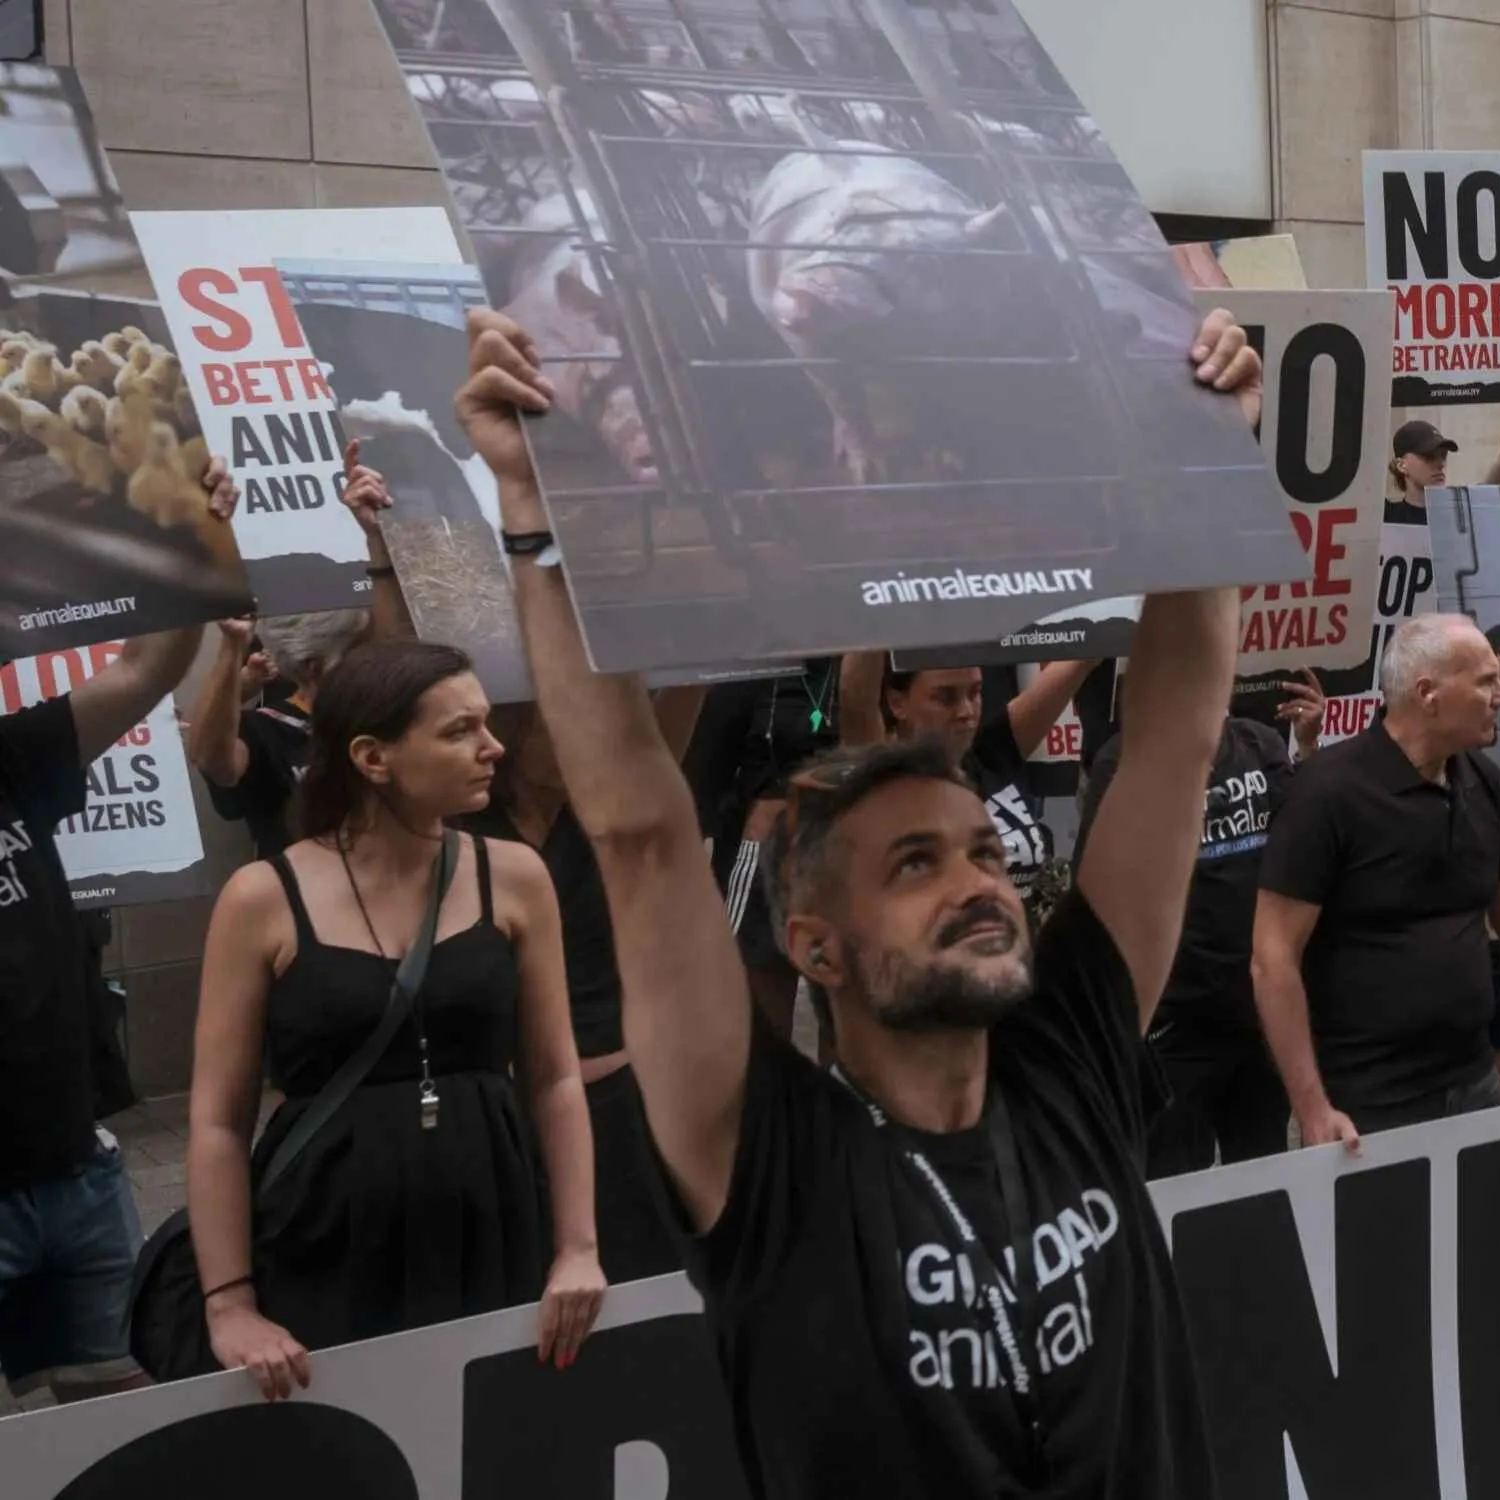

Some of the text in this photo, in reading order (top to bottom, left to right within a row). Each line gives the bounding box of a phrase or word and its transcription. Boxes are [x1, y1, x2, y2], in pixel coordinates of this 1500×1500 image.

[1240, 323, 1366, 503] O
[246, 474, 325, 514] AND
[861, 568, 1093, 605] animalEQUALITY
[1379, 555, 1433, 617] OP
[19, 597, 136, 631] animalEQUALITY
